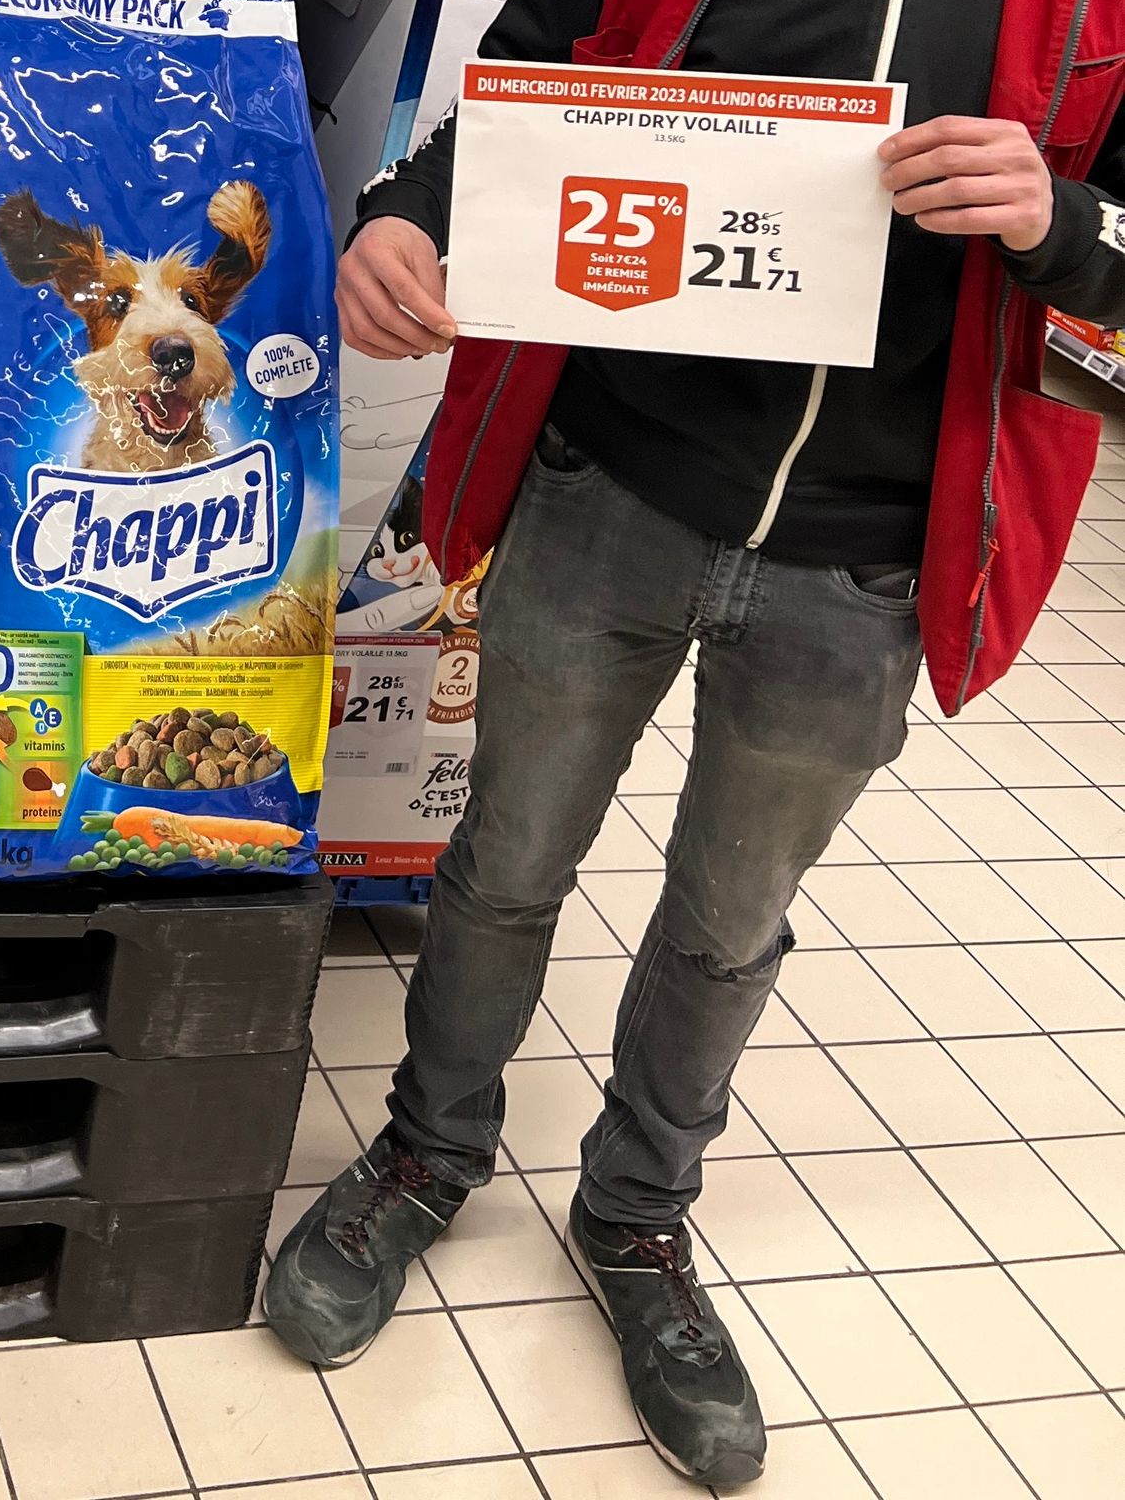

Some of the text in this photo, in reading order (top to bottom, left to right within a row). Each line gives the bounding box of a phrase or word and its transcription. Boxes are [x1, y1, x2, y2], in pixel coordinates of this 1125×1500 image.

[477, 77, 877, 116] DU MERCREDI 01 FEVRIER 2023 AU LUNDI 06 FEVRIER 2023
[563, 109, 779, 136] CHAPPI DRY VOLAILLE
[654, 133, 686, 144] 13.5KG
[590, 252, 647, 266] Soit 7€24
[586, 266, 649, 280] DE REMISE
[582, 279, 650, 296] IMMÉDIATE
[264, 345, 295, 364] 100%
[255, 357, 314, 385] COMPLETE
[15, 470, 263, 588] Chappi
[450, 656, 470, 680] 2
[437, 682, 472, 696] kcal
[24, 738, 66, 753] vitamins
[22, 805, 63, 820] proteins
[2, 835, 34, 868] kg
